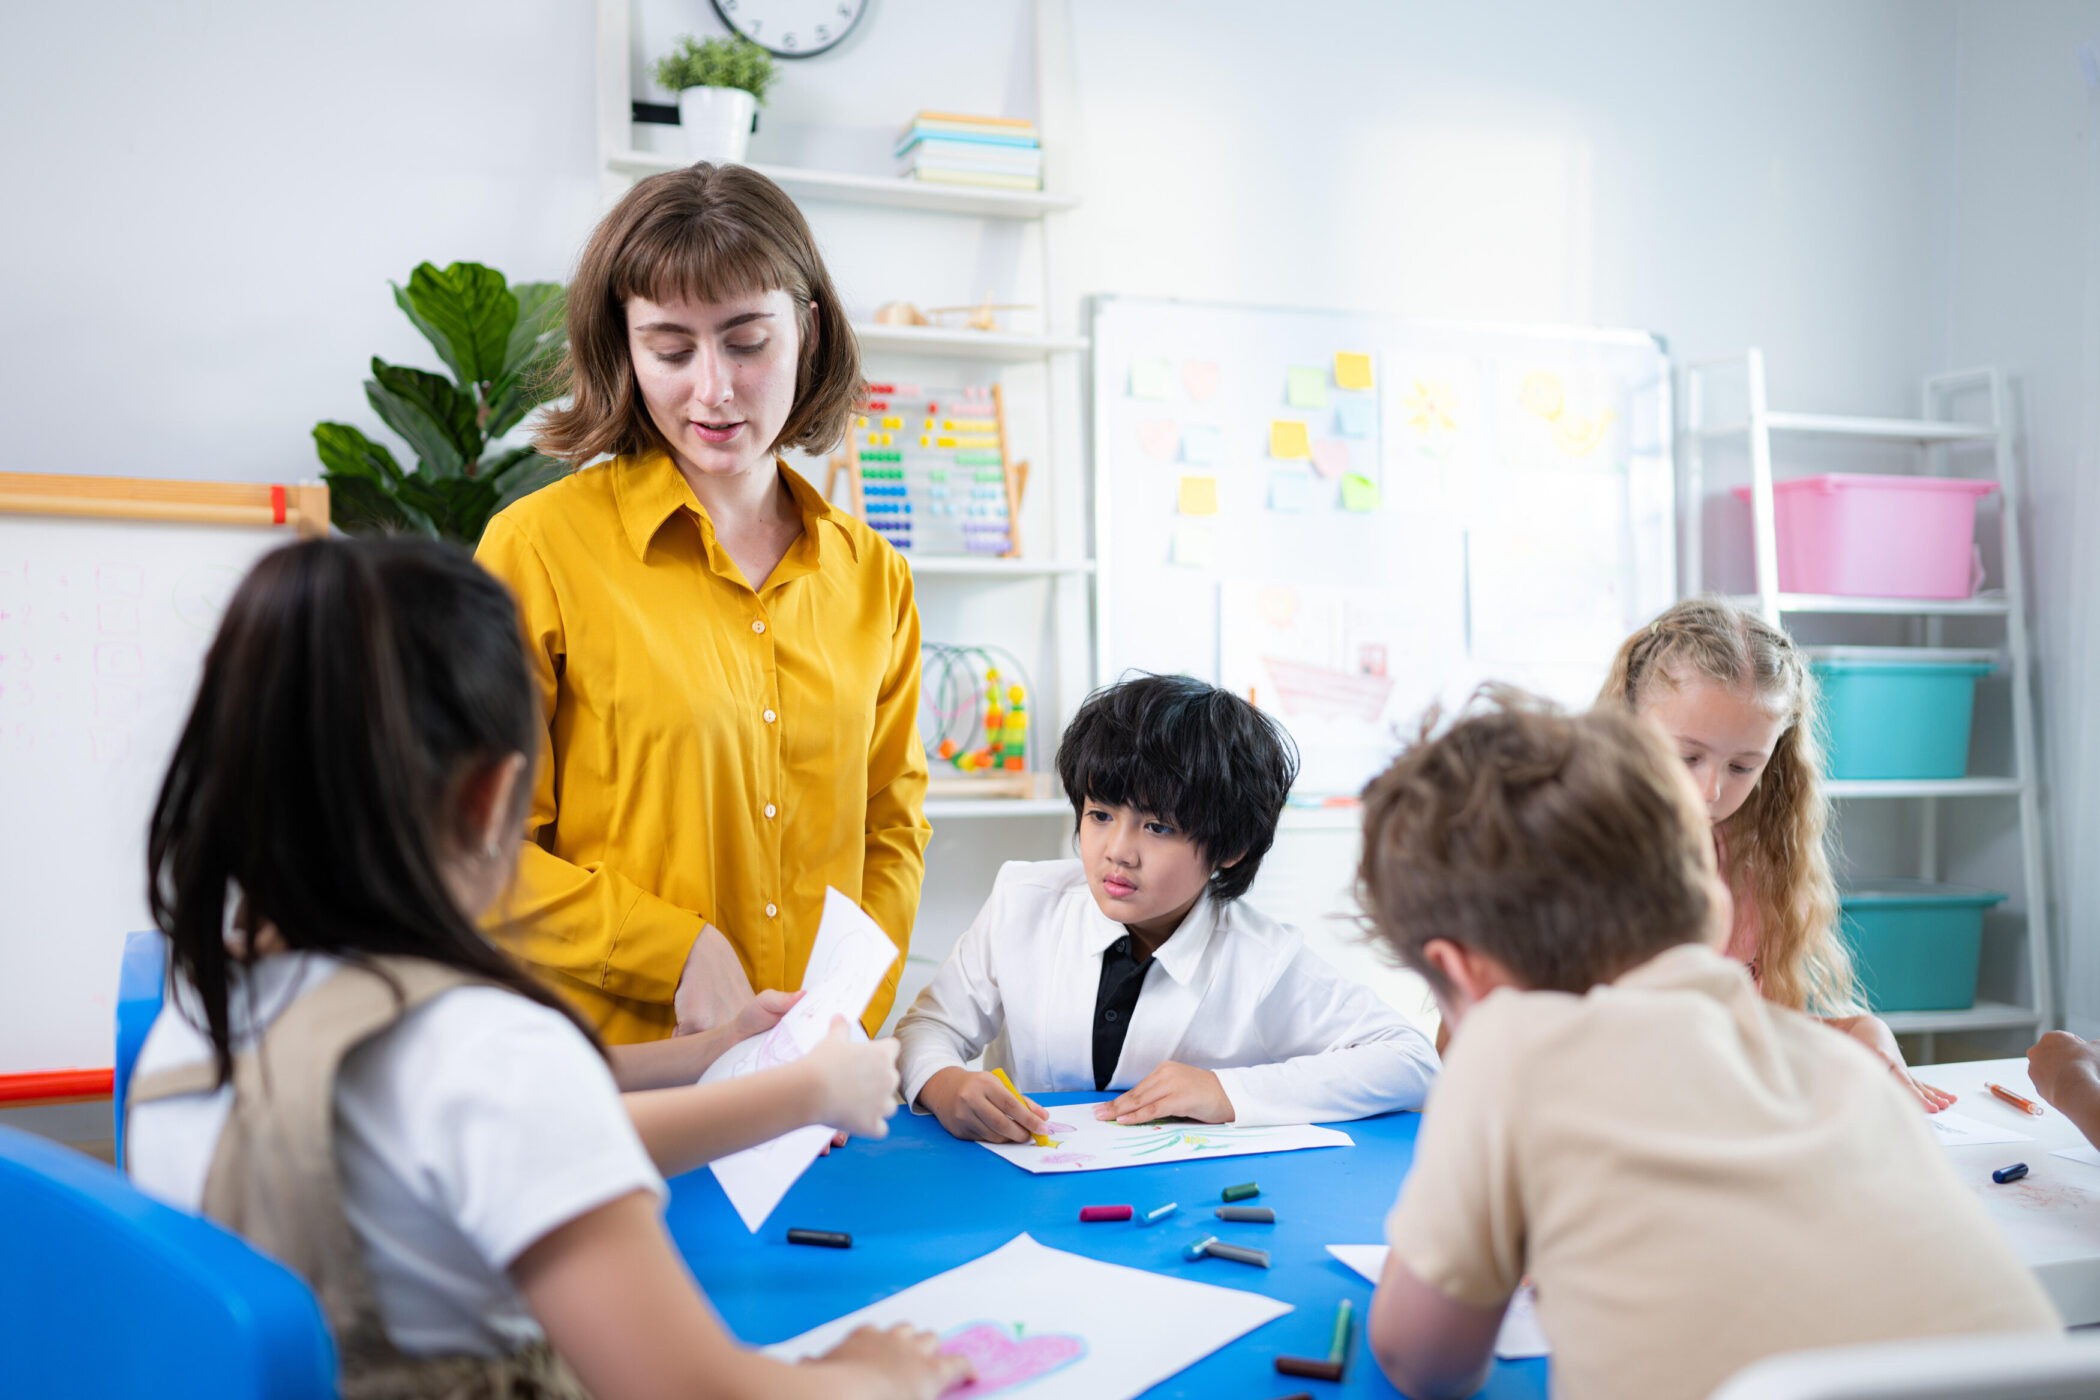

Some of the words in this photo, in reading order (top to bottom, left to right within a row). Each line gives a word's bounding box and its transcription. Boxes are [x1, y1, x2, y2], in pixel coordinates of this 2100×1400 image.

[750, 19, 764, 37] 7
[815, 24, 830, 42] 5
[782, 32, 797, 49] 6
